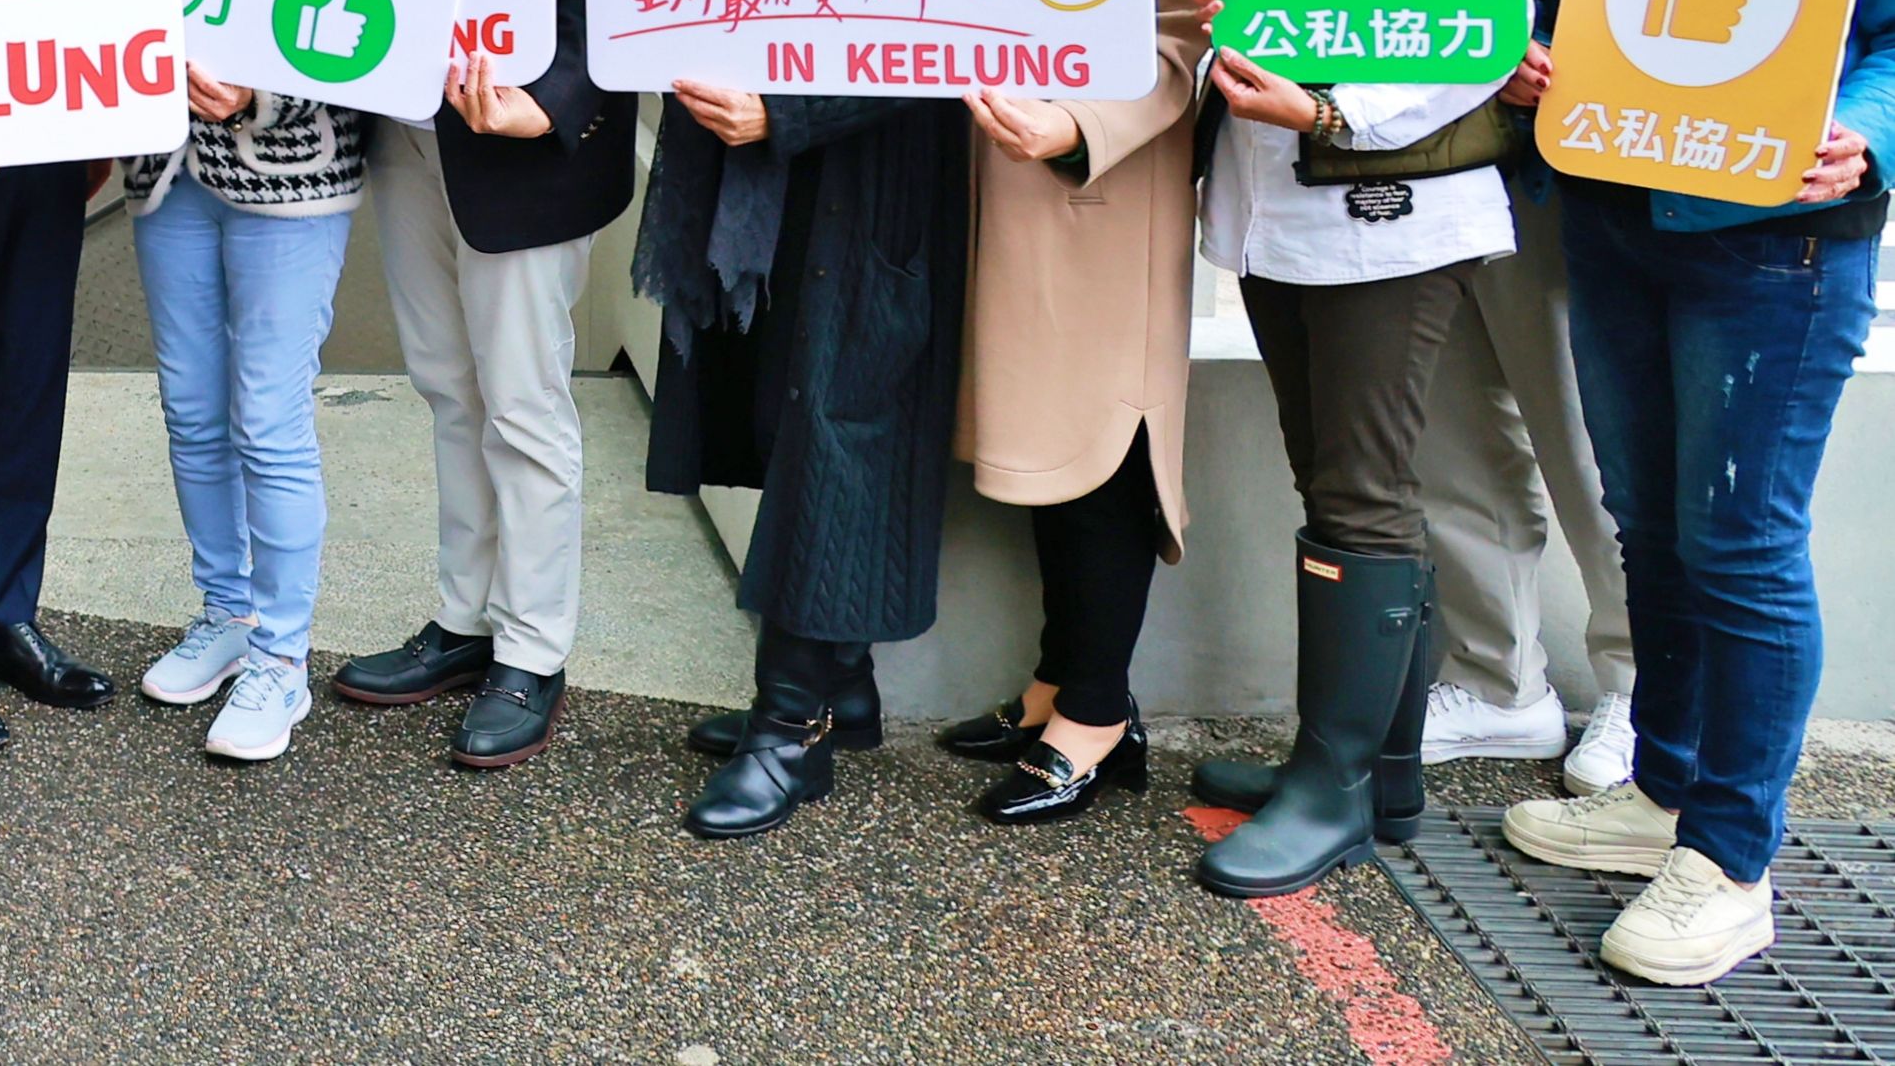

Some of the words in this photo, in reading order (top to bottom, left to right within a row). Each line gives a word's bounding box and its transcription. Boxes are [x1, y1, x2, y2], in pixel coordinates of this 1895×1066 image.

[1243, 8, 1494, 59] 公私協力
[767, 42, 815, 82] IN
[847, 44, 1090, 86] KEELUNG
[1560, 101, 1787, 180] 公私協力
